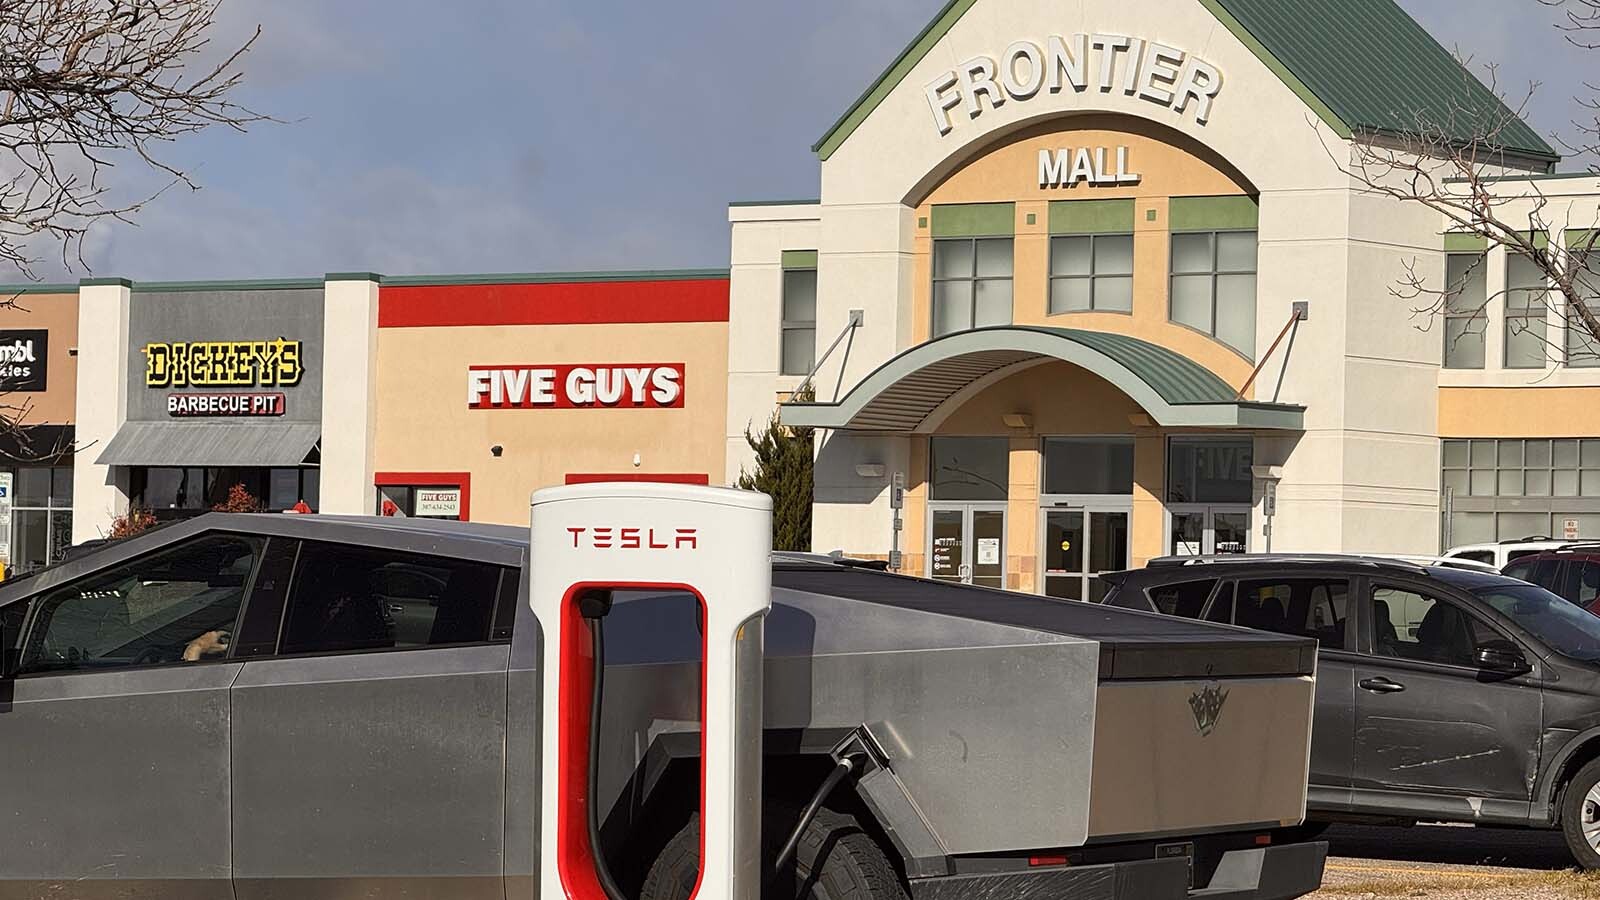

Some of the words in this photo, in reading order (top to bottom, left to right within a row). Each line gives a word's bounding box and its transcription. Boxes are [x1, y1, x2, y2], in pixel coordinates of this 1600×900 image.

[925, 34, 1223, 137] FRONTIER
[1037, 146, 1142, 189] MALL
[168, 396, 249, 412] BARBECUE
[253, 396, 277, 412] PIT
[468, 369, 556, 406] FIVE
[565, 366, 681, 406] GUYS
[567, 527, 697, 549] TESLA
